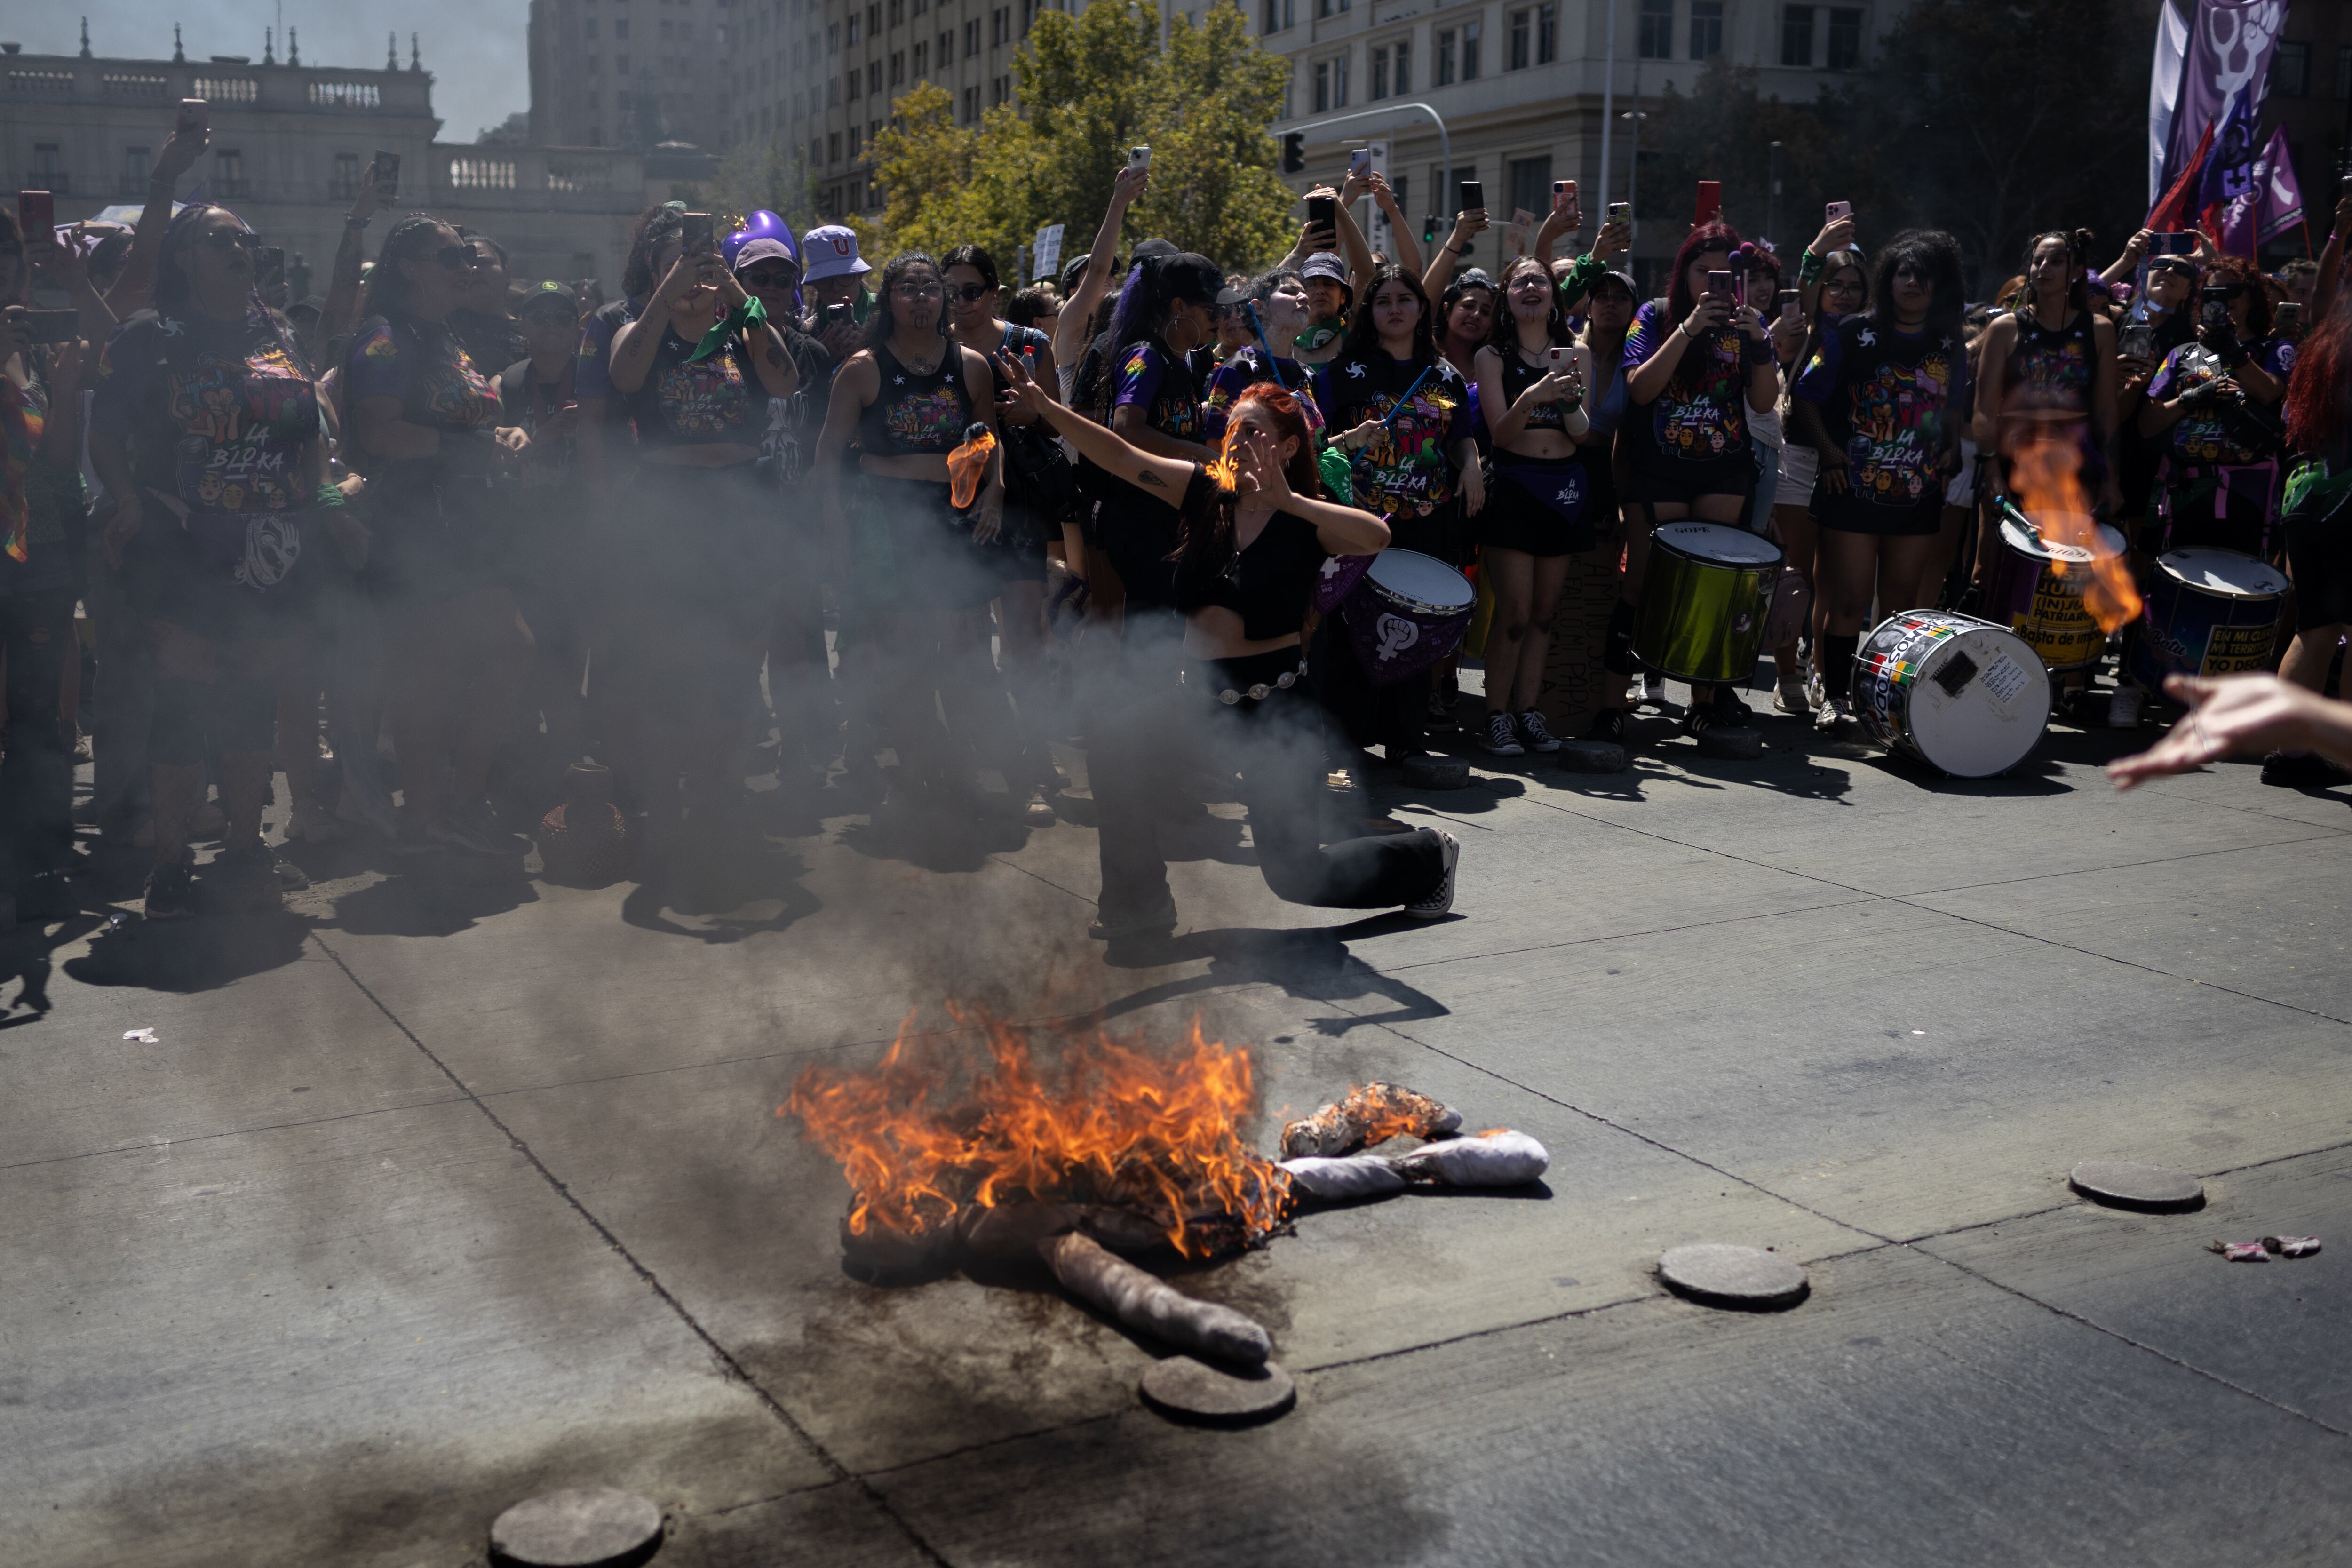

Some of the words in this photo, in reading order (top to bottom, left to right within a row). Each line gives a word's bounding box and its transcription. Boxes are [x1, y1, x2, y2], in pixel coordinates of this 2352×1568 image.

[832, 238, 850, 256] U
[1692, 394, 1710, 407] LA
[244, 423, 270, 446] LA
[1897, 429, 1916, 446] LA
[1399, 456, 1416, 473] LA
[1569, 478, 1576, 490] LA
[2036, 596, 2084, 612] (IN)JU
[1585, 613, 1611, 638] NO
[2058, 632, 2074, 645] de
[2214, 631, 2232, 641] EN
[2233, 631, 2248, 642] MI
[2211, 643, 2225, 653] MI
[2208, 659, 2231, 671] YO
